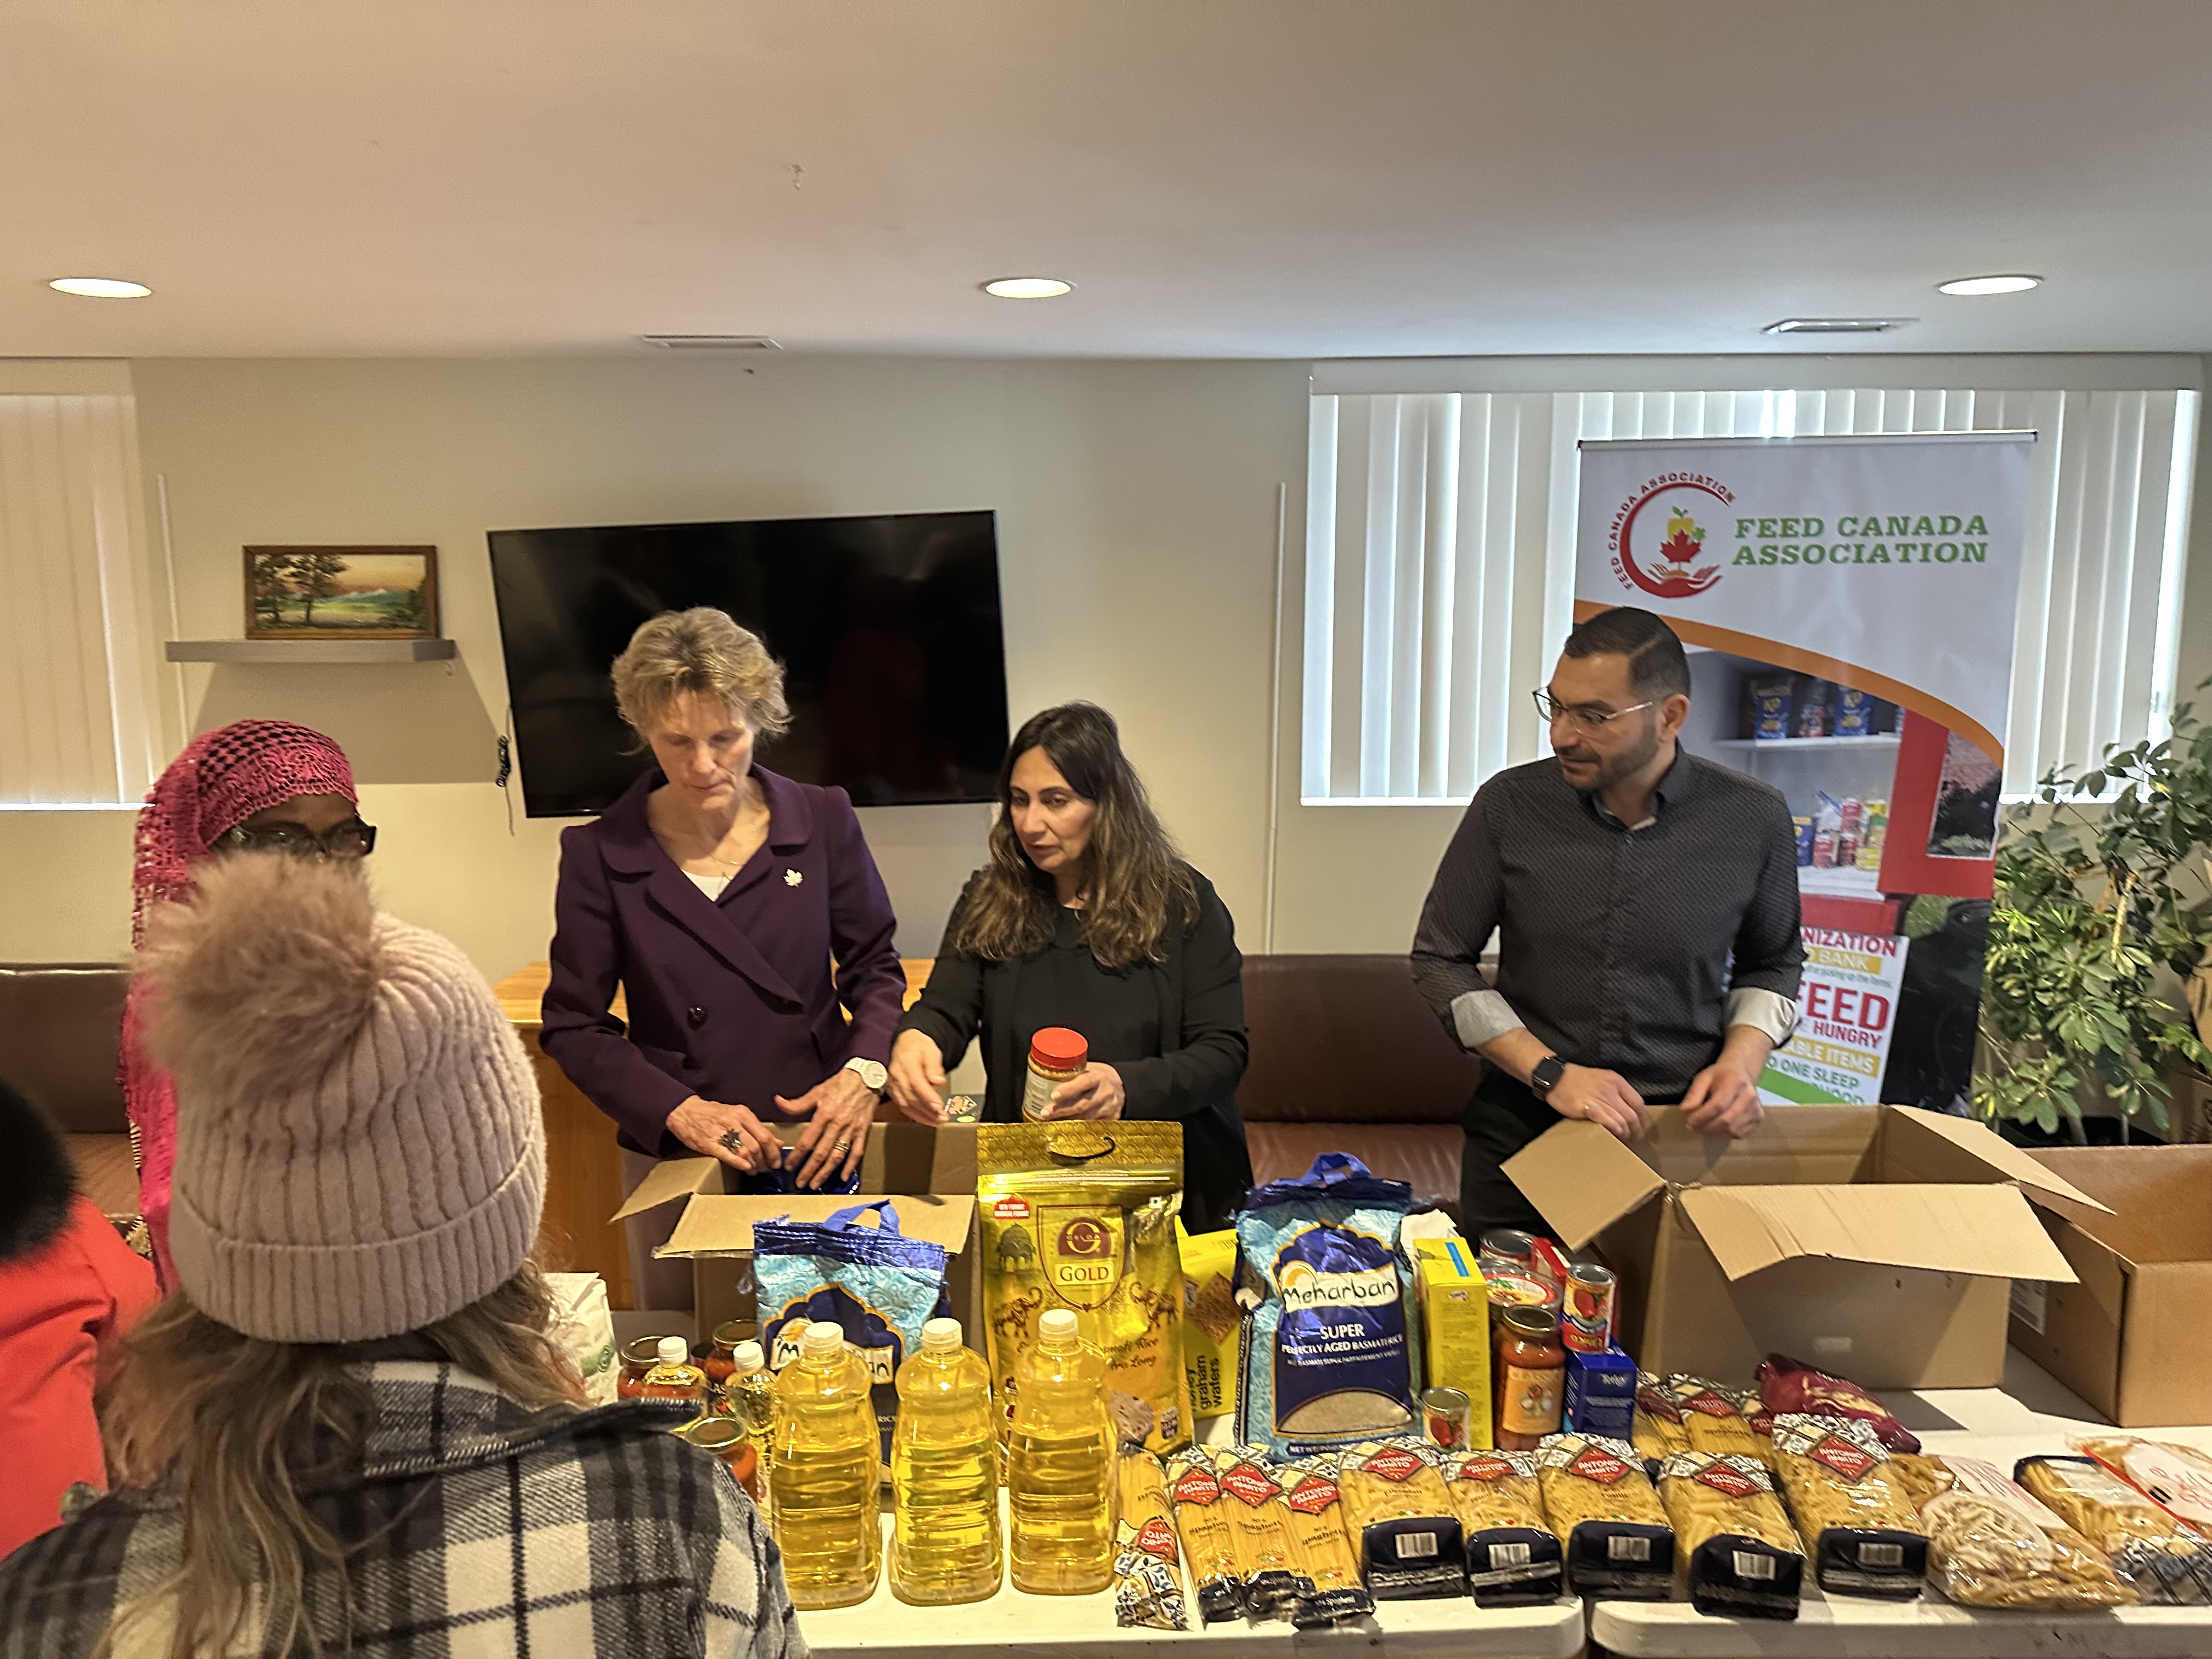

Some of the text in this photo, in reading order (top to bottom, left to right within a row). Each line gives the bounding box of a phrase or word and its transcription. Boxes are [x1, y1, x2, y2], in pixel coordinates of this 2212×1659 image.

[1608, 472, 1736, 590] FEED CANADA ASSOCIATION
[1735, 514, 1989, 539] FEED CANADA
[1731, 541, 1989, 566] ASSOCIATION
[1819, 950, 1869, 971] BANK
[1813, 1020, 1882, 1048] HUNGRY
[1825, 1047, 1875, 1074] ITEMS
[1781, 1058, 1810, 1078] ONE
[1812, 1066, 1861, 1090] SLEEP
[1059, 1266, 1109, 1282] GOLD
[1282, 1278, 1396, 1305] Meharban
[1319, 1323, 1365, 1340] SUPER
[1324, 1341, 1351, 1353] AGED
[1196, 1355, 1212, 1410] graham
[1209, 1357, 1222, 1408] wafers
[1371, 1455, 1414, 1466] ANTONIO
[1578, 1459, 1622, 1470] ANTONIO
[1226, 1475, 1271, 1488] ANTONIO
[1232, 1481, 1268, 1493] AMATO
[1291, 1485, 1336, 1502] ANTONIO
